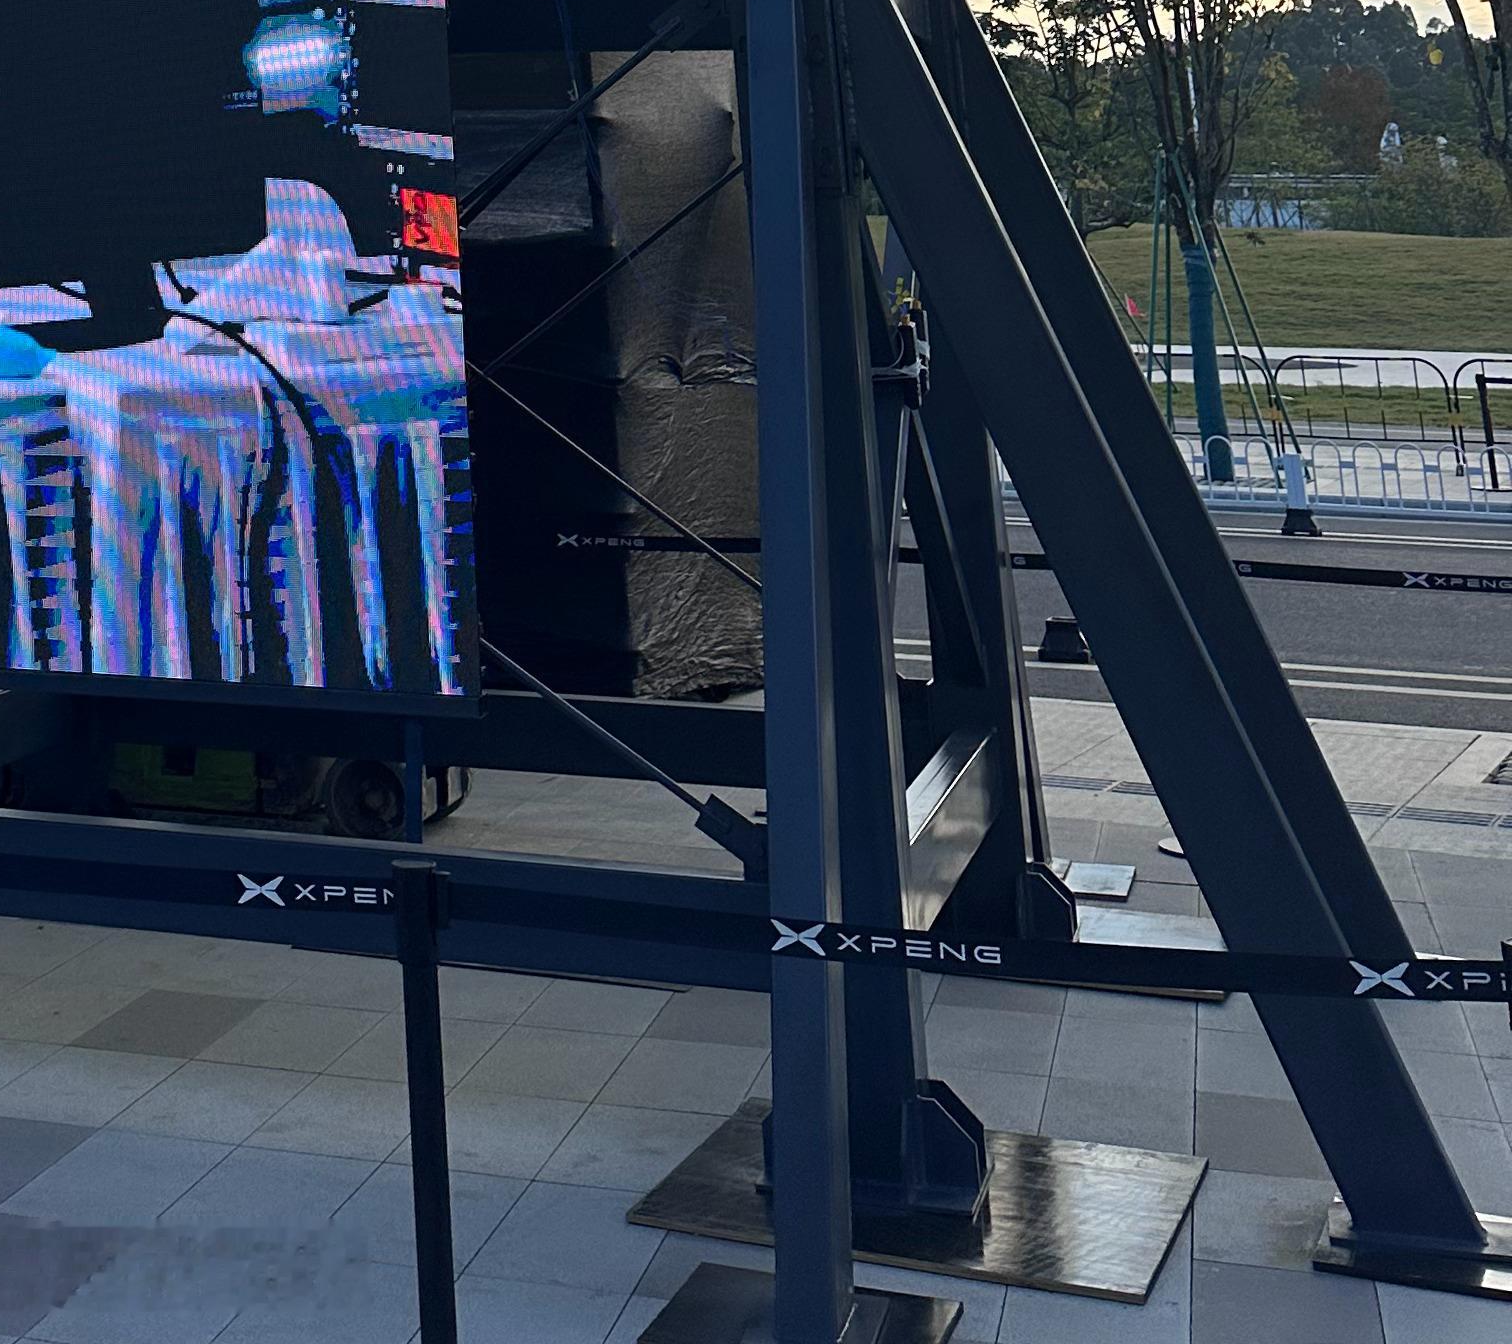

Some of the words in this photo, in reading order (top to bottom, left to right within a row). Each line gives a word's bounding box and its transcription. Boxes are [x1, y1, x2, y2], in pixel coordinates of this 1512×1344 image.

[582, 536, 645, 547] XPENG
[1434, 575, 1512, 589] XPENG
[837, 932, 1001, 964] XPENG
